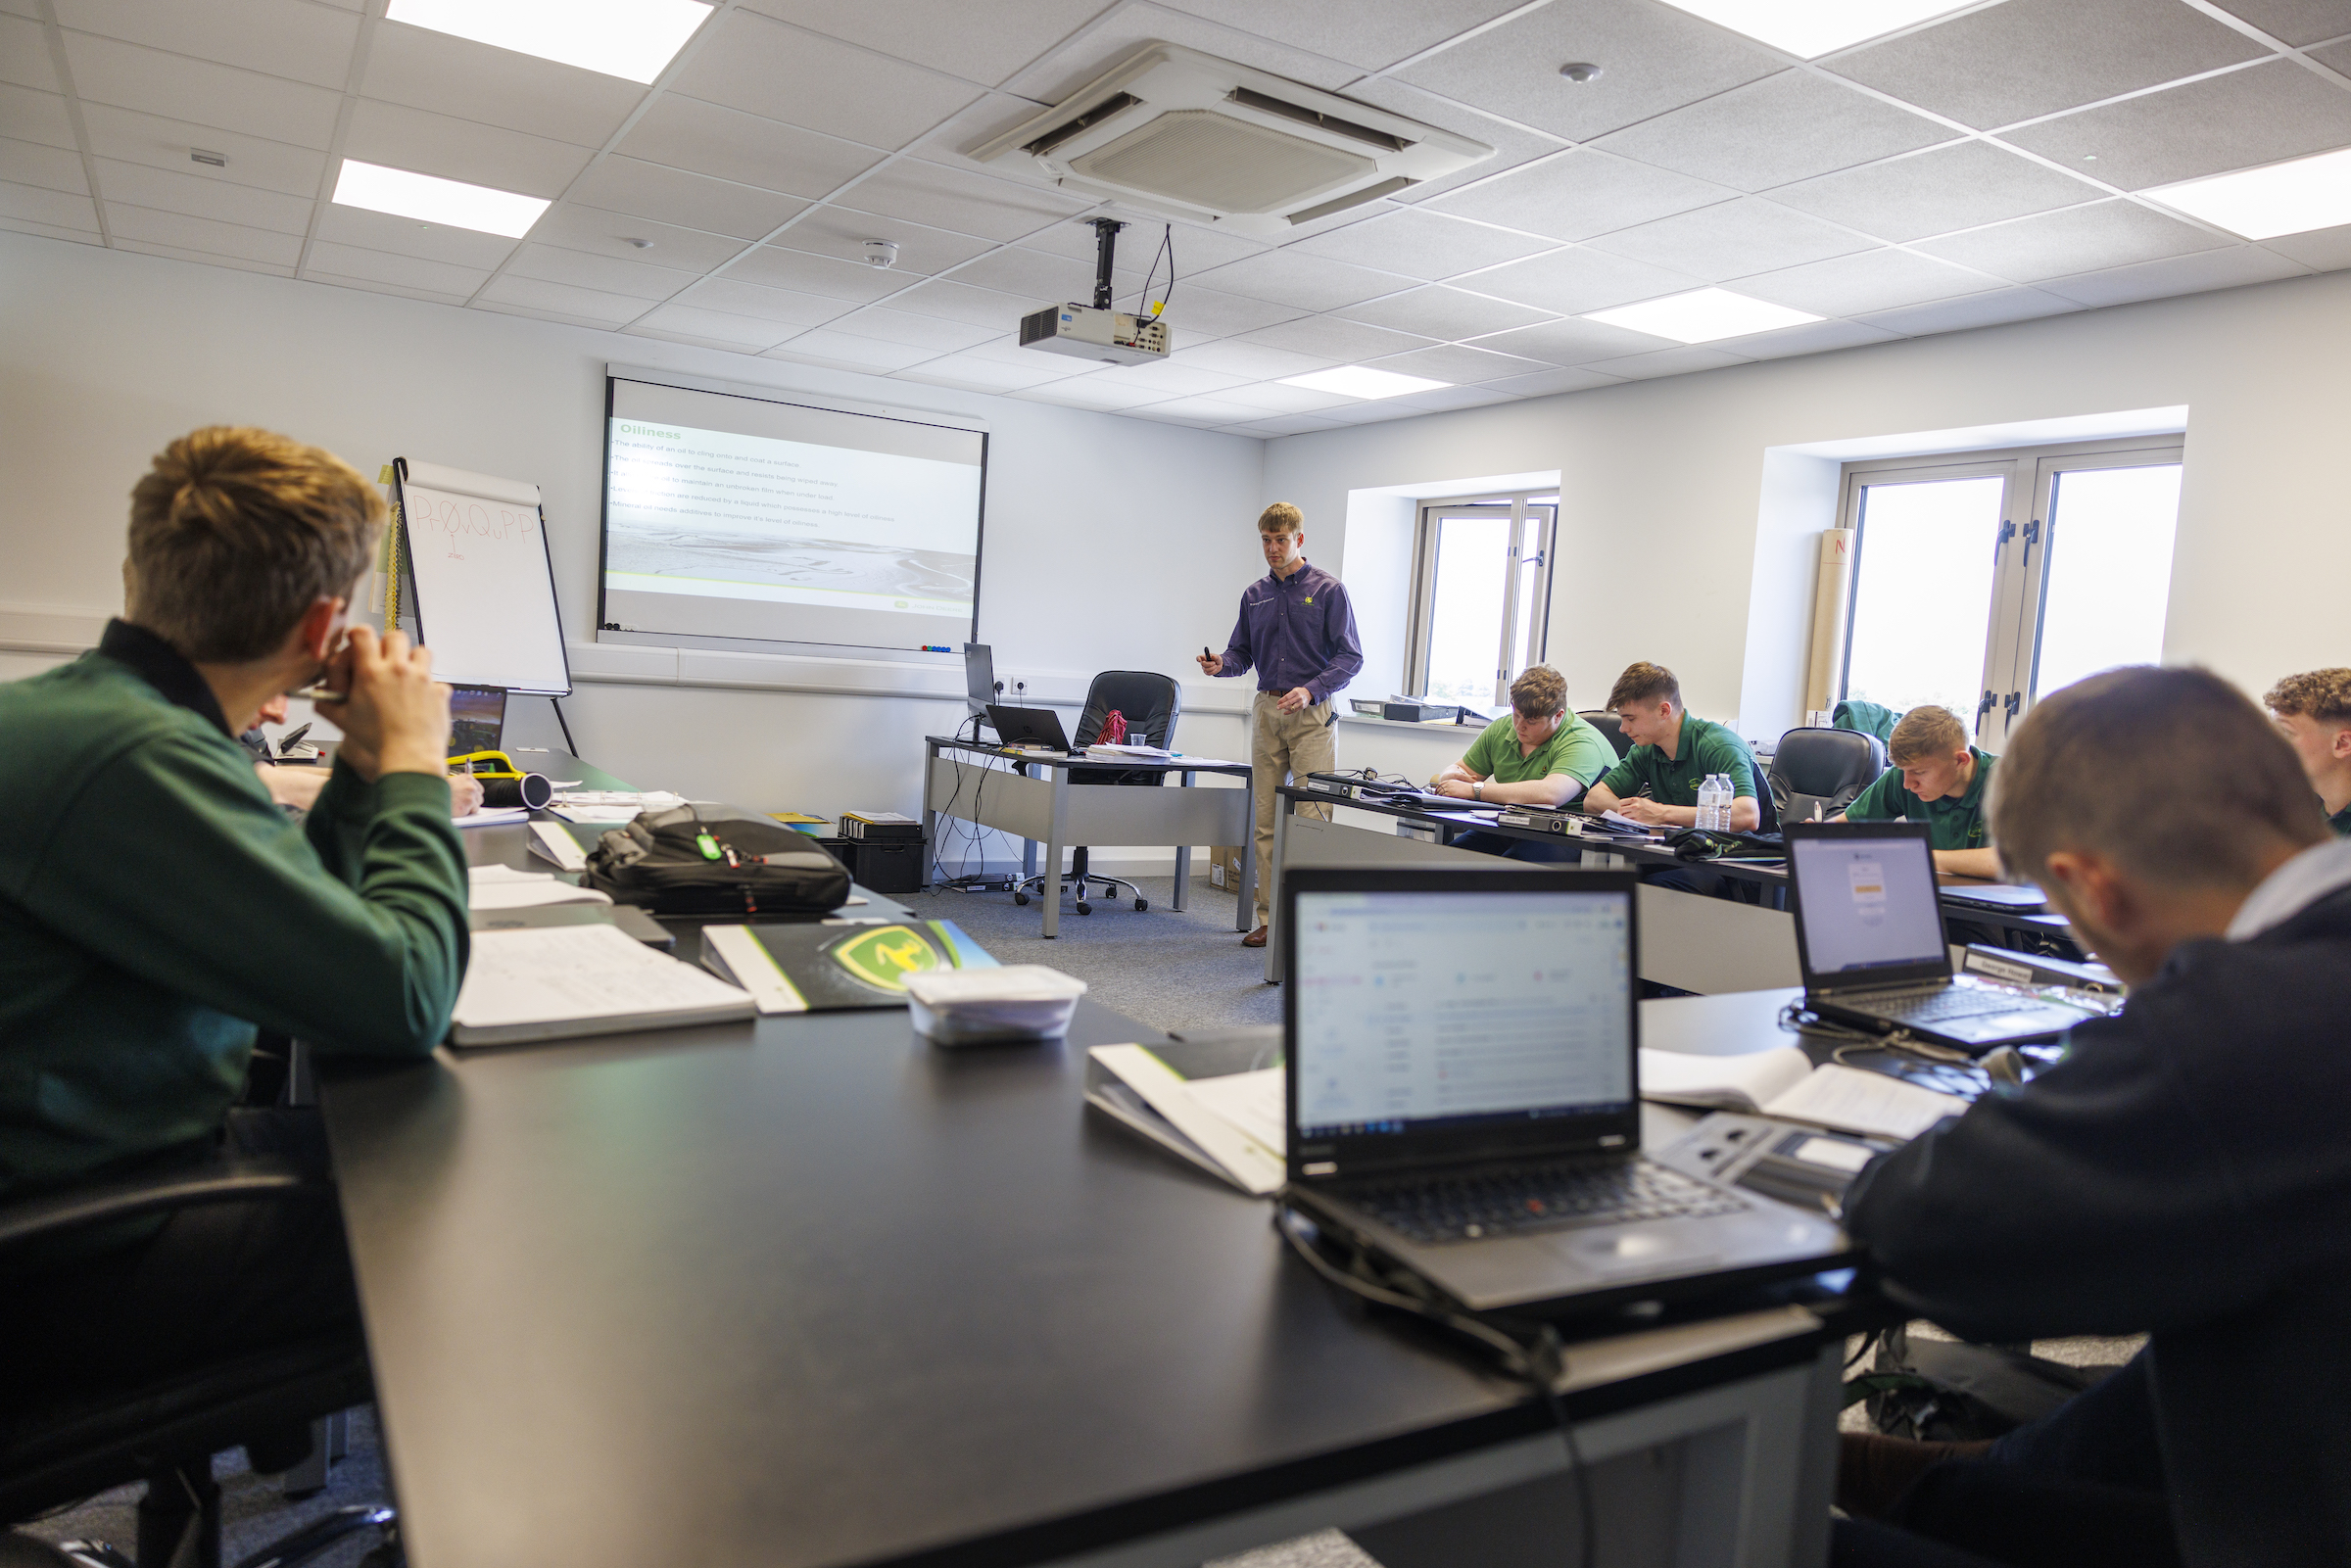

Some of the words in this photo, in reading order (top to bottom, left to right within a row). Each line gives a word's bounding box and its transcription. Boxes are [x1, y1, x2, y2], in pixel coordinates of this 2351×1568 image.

[621, 424, 681, 439] Oiliness
[632, 442, 654, 450] ability
[643, 459, 673, 467] spreads
[751, 471, 774, 480] resists
[776, 475, 796, 483] being
[798, 477, 818, 485] wiped
[681, 478, 713, 487] maintain
[726, 484, 759, 492] unbroken
[691, 495, 721, 503] reduced
[740, 500, 759, 508] liquid
[783, 505, 820, 514] possesses
[679, 508, 712, 516] additives
[723, 513, 752, 521] improve
